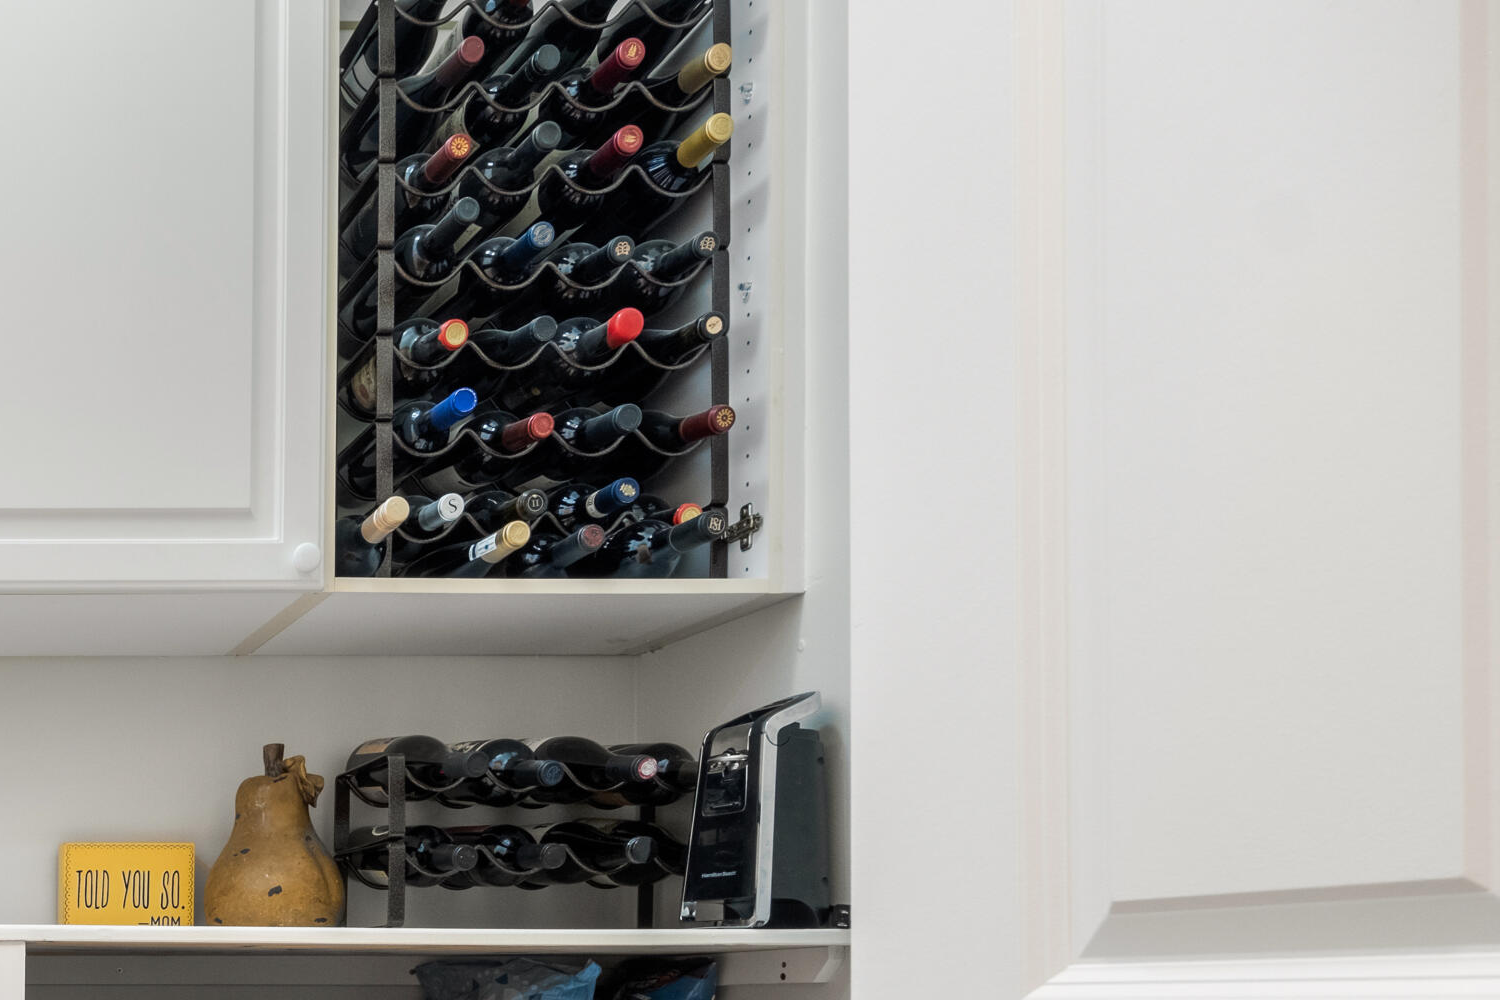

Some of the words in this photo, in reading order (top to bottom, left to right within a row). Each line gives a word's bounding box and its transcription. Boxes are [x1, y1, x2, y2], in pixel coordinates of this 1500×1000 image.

[76, 869, 110, 909] TOLD
[122, 870, 150, 909] YOU
[160, 870, 185, 910] SO.
